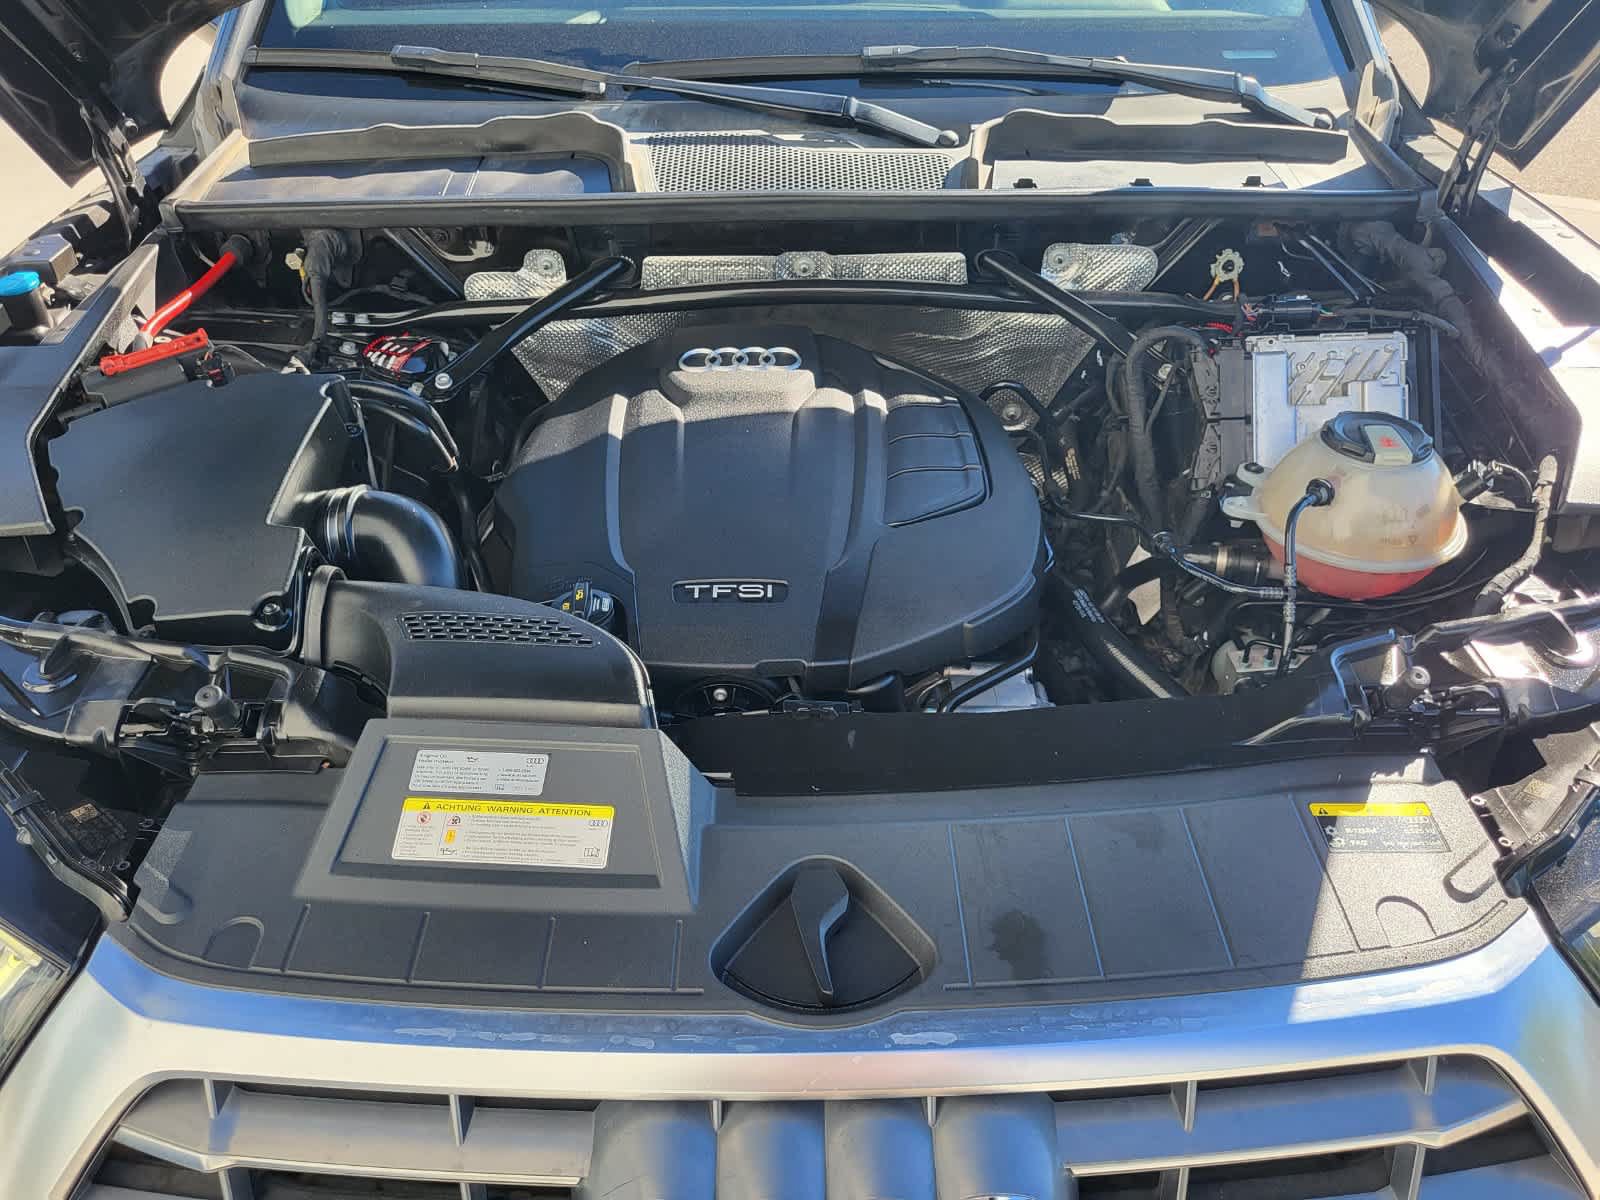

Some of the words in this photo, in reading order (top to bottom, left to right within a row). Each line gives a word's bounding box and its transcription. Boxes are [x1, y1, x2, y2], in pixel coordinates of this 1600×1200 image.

[684, 584, 773, 599] TFSI
[436, 803, 481, 812] ACHTUNG
[487, 805, 534, 815] WARNING
[538, 807, 592, 817] ATTENTION
